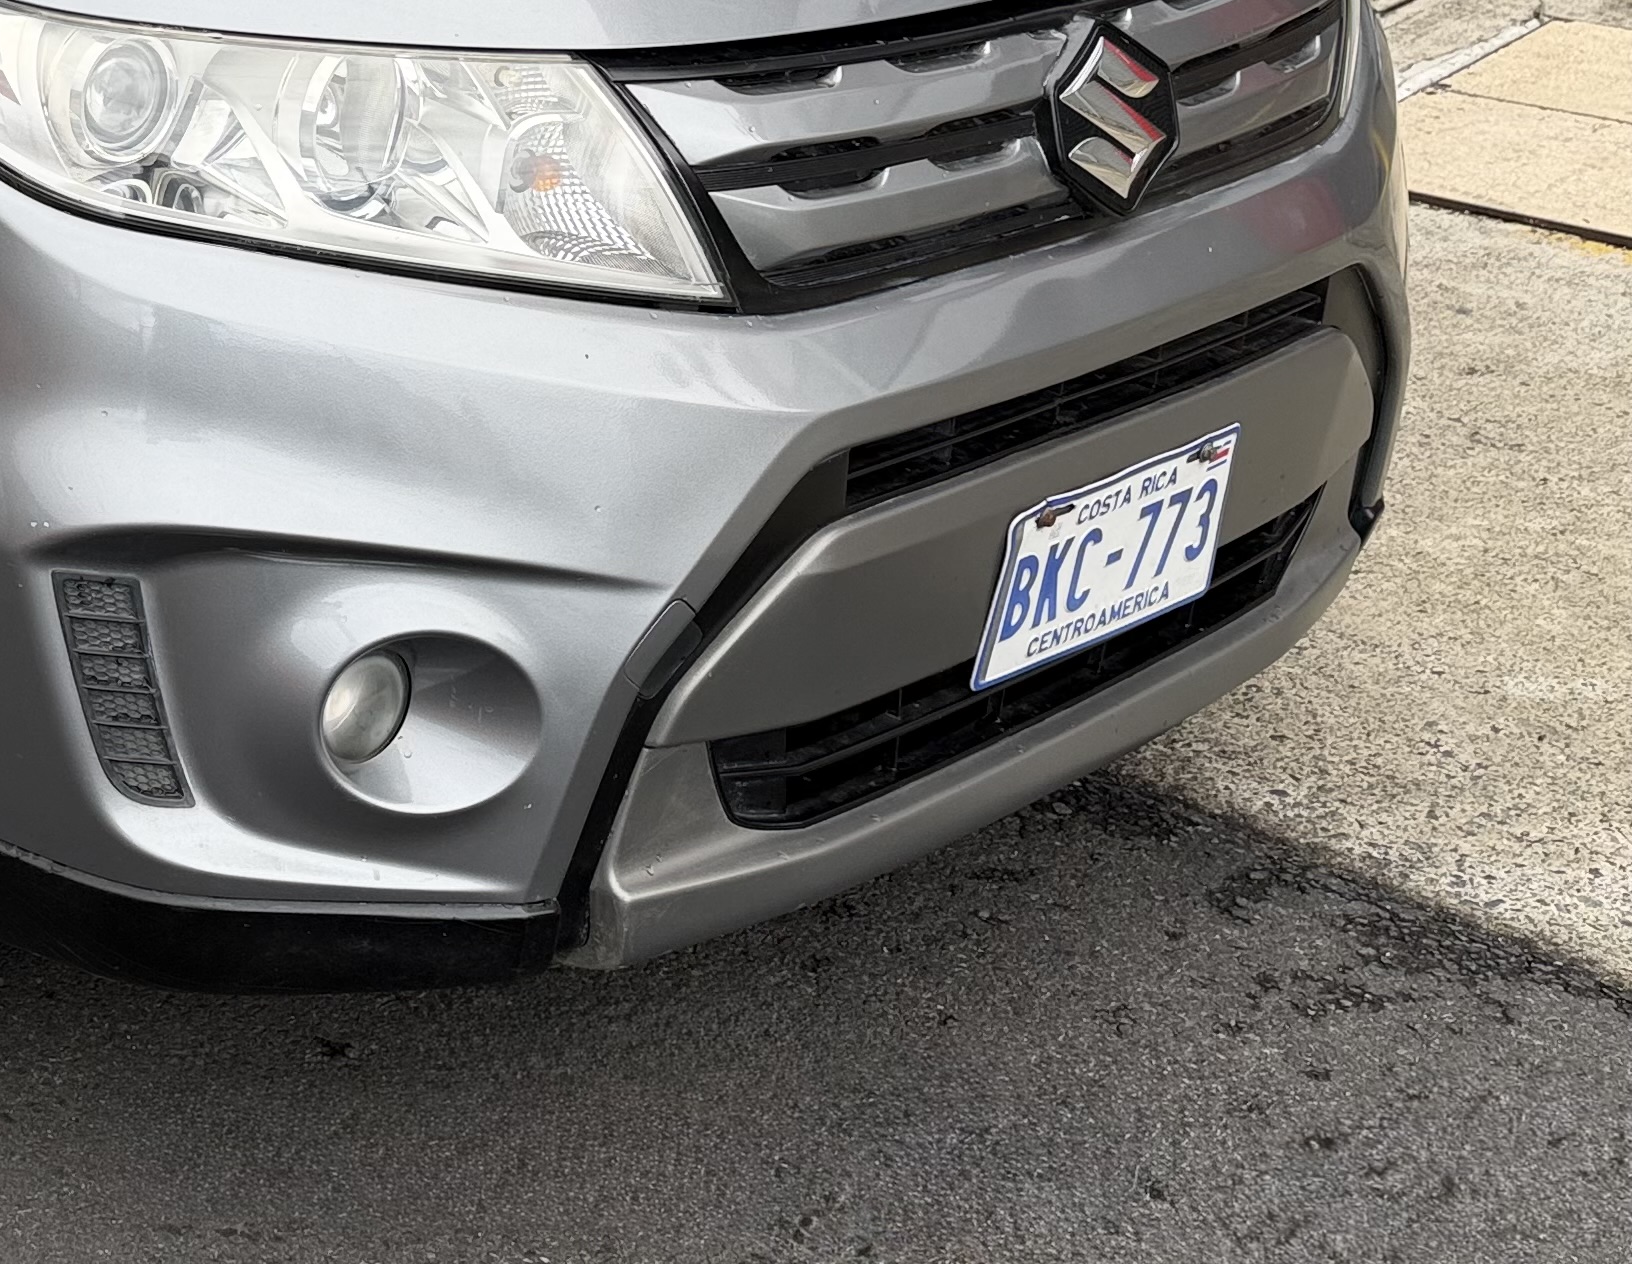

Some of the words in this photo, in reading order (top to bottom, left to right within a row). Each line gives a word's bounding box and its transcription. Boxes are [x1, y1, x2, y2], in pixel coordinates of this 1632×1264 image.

[1077, 486, 1132, 525] COSTA
[1137, 466, 1178, 500] RICA
[998, 478, 1219, 643] BKC-773
[1026, 581, 1170, 657] CENTROAMERICA
